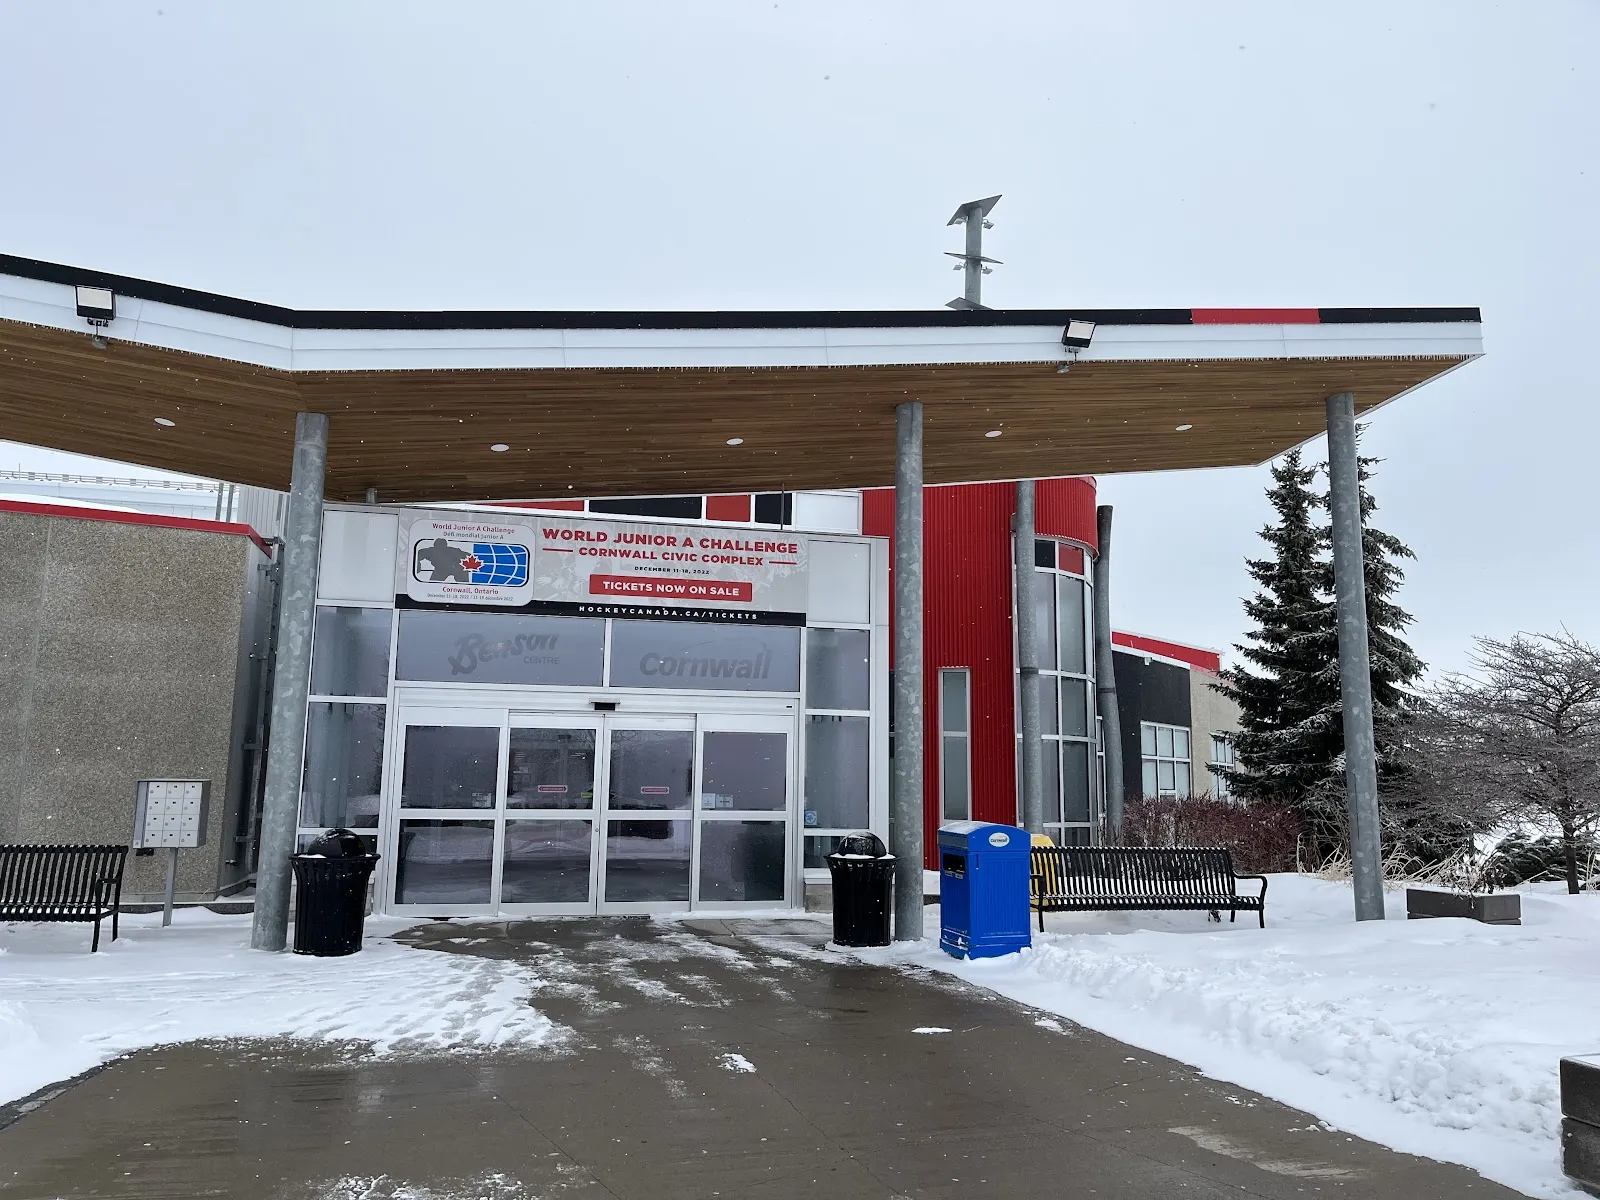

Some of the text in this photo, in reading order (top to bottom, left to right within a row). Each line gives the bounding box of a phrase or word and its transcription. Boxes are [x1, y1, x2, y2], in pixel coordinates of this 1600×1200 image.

[482, 525, 515, 534] Challenge
[542, 528, 798, 554] WORLD JUNIOR A CHALLENGE
[578, 547, 764, 566] CORNWALL CIVIC COMPLEX
[442, 586, 499, 595] Cornwall, Ontario
[603, 580, 740, 596] TICKETS NOW ON SALE
[579, 605, 757, 620] HOCKEYCANADA.CA/TICKETS
[447, 633, 560, 675] Benson
[523, 655, 560, 665] CENTRE
[639, 650, 772, 680] Cornwall
